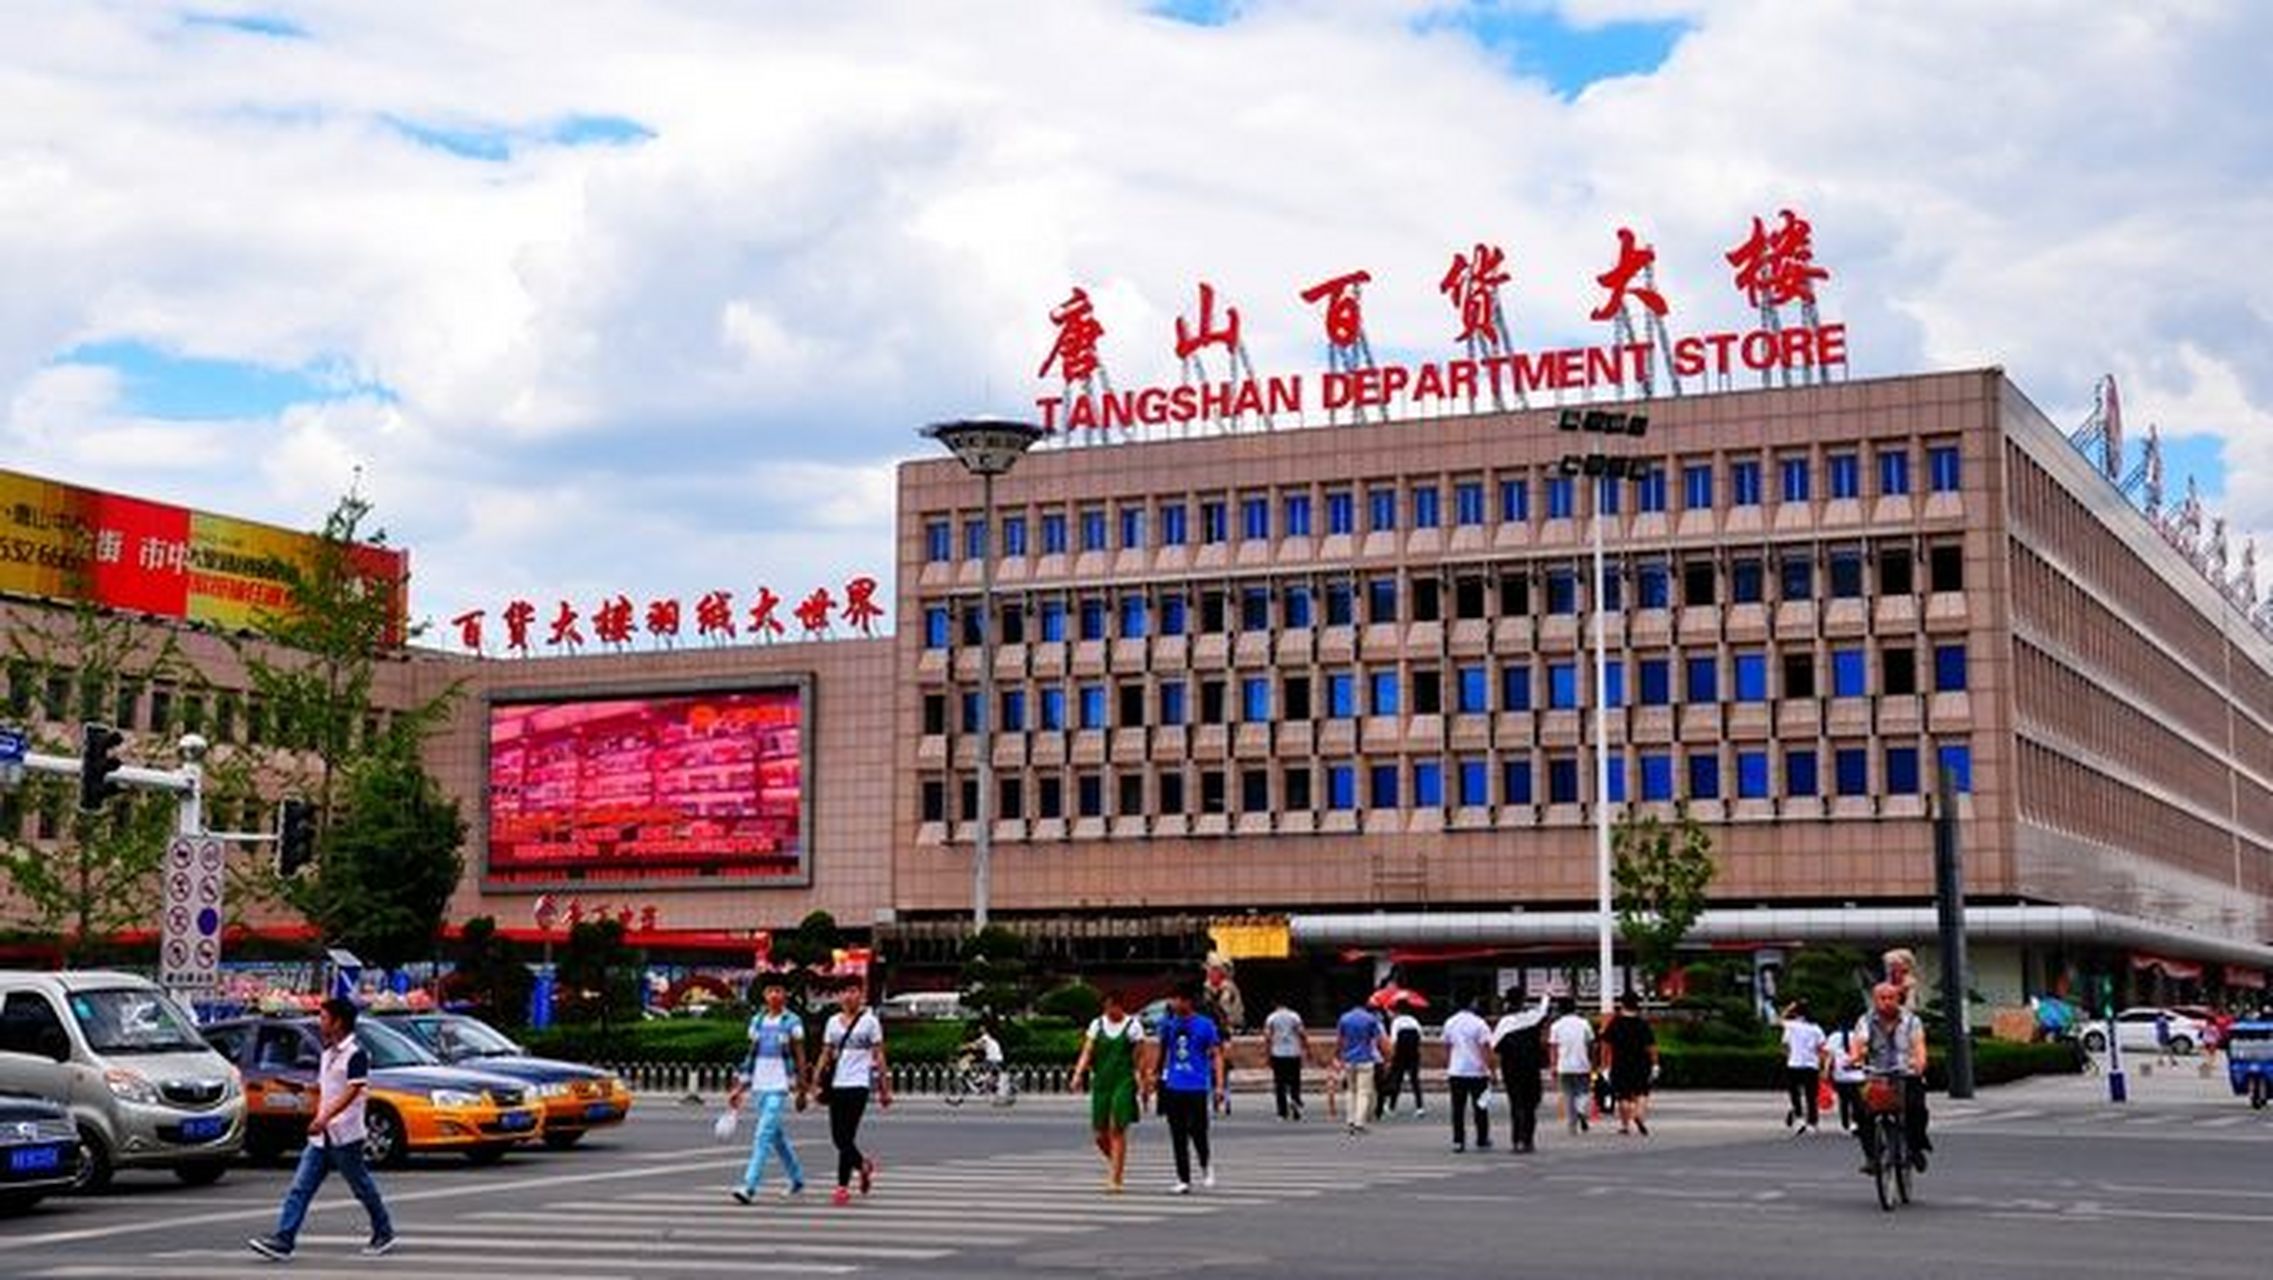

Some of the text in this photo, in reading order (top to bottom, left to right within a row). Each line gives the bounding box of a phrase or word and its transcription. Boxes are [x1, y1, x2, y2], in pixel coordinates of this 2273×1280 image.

[1036, 324, 1846, 431] TANGSHAN DEPARTMENT STORE
